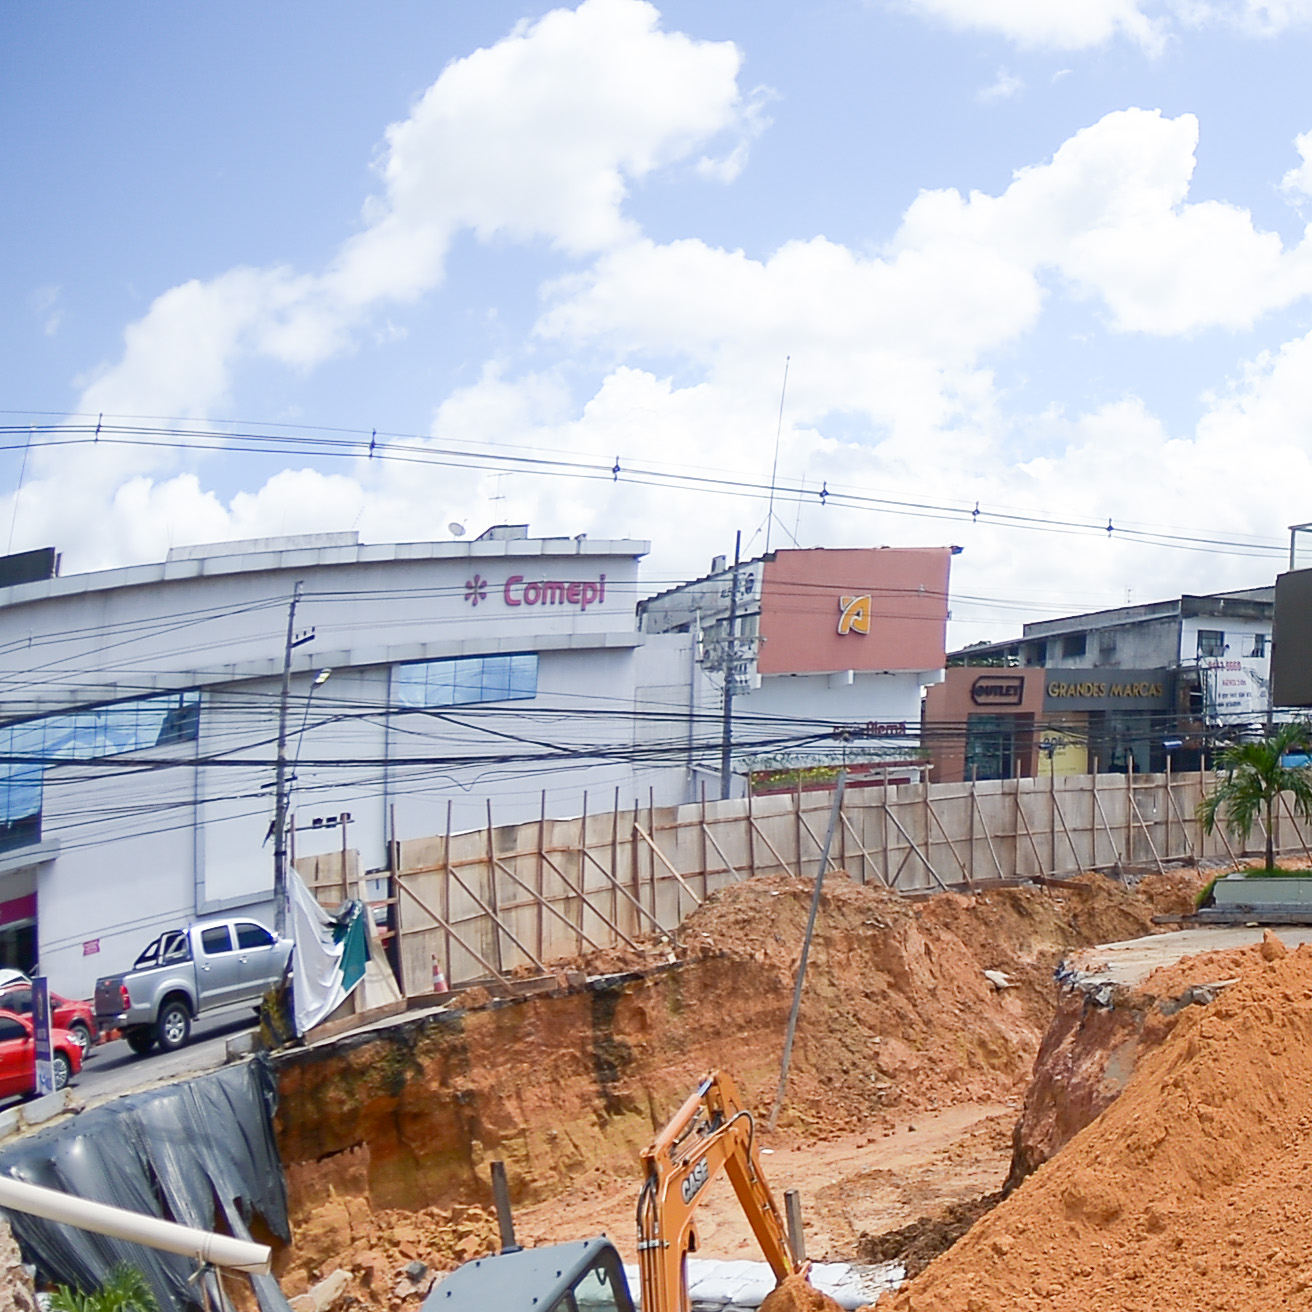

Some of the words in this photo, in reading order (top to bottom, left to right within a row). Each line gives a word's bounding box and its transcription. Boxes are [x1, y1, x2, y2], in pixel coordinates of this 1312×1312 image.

[504, 574, 606, 611] Comepi
[974, 684, 1020, 697] OUTLET
[1048, 682, 1107, 697] GRANDES
[1110, 682, 1163, 698] MARCAS
[681, 1155, 708, 1204] CASE
